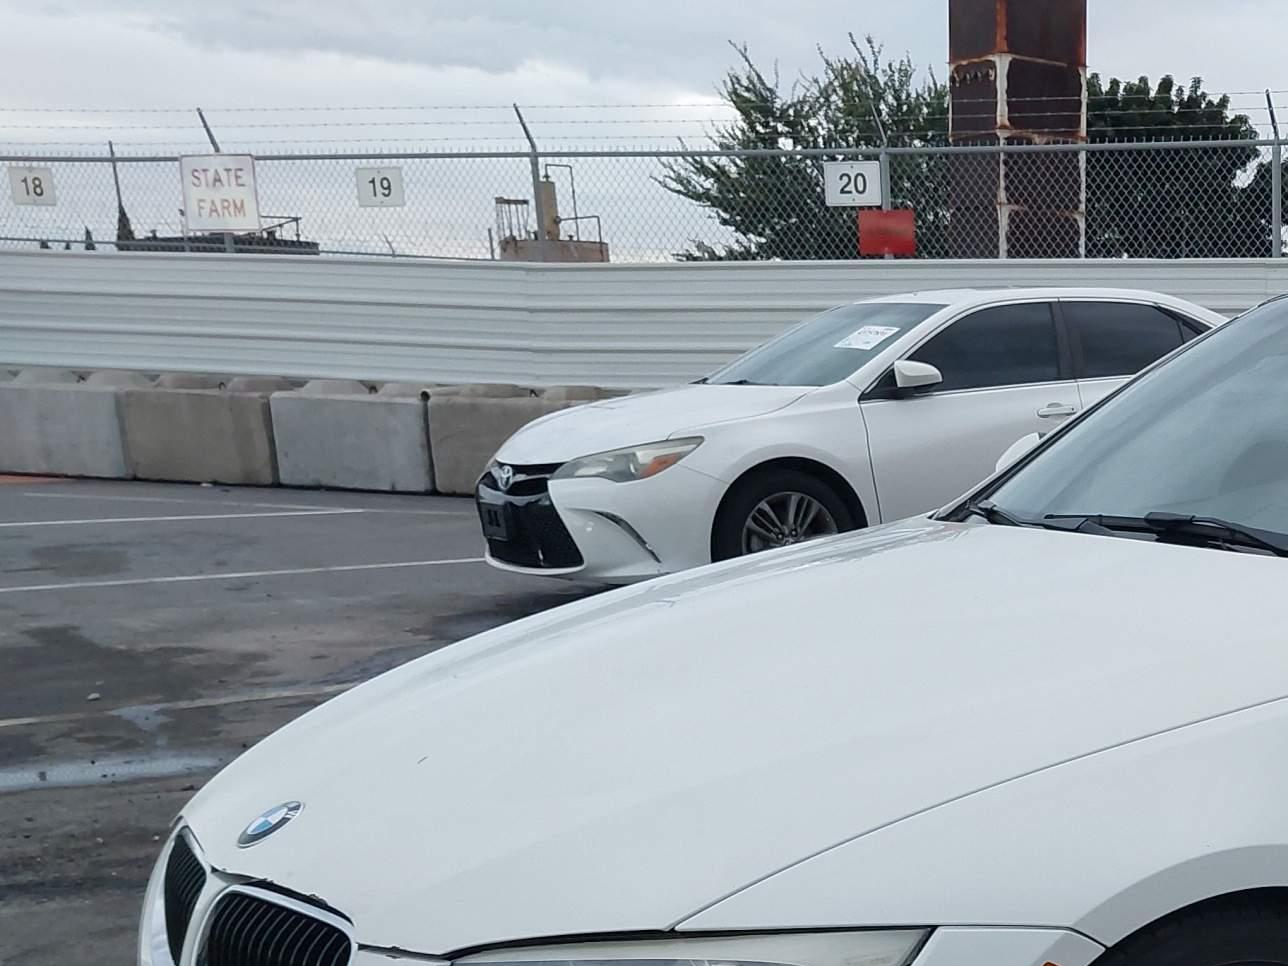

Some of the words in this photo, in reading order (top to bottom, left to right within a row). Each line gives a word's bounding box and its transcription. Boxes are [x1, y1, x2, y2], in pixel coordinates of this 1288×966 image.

[21, 177, 44, 197] 18
[191, 168, 245, 188] STATE
[368, 176, 392, 198] 19
[839, 172, 867, 194] 20
[197, 199, 247, 218] FARM
